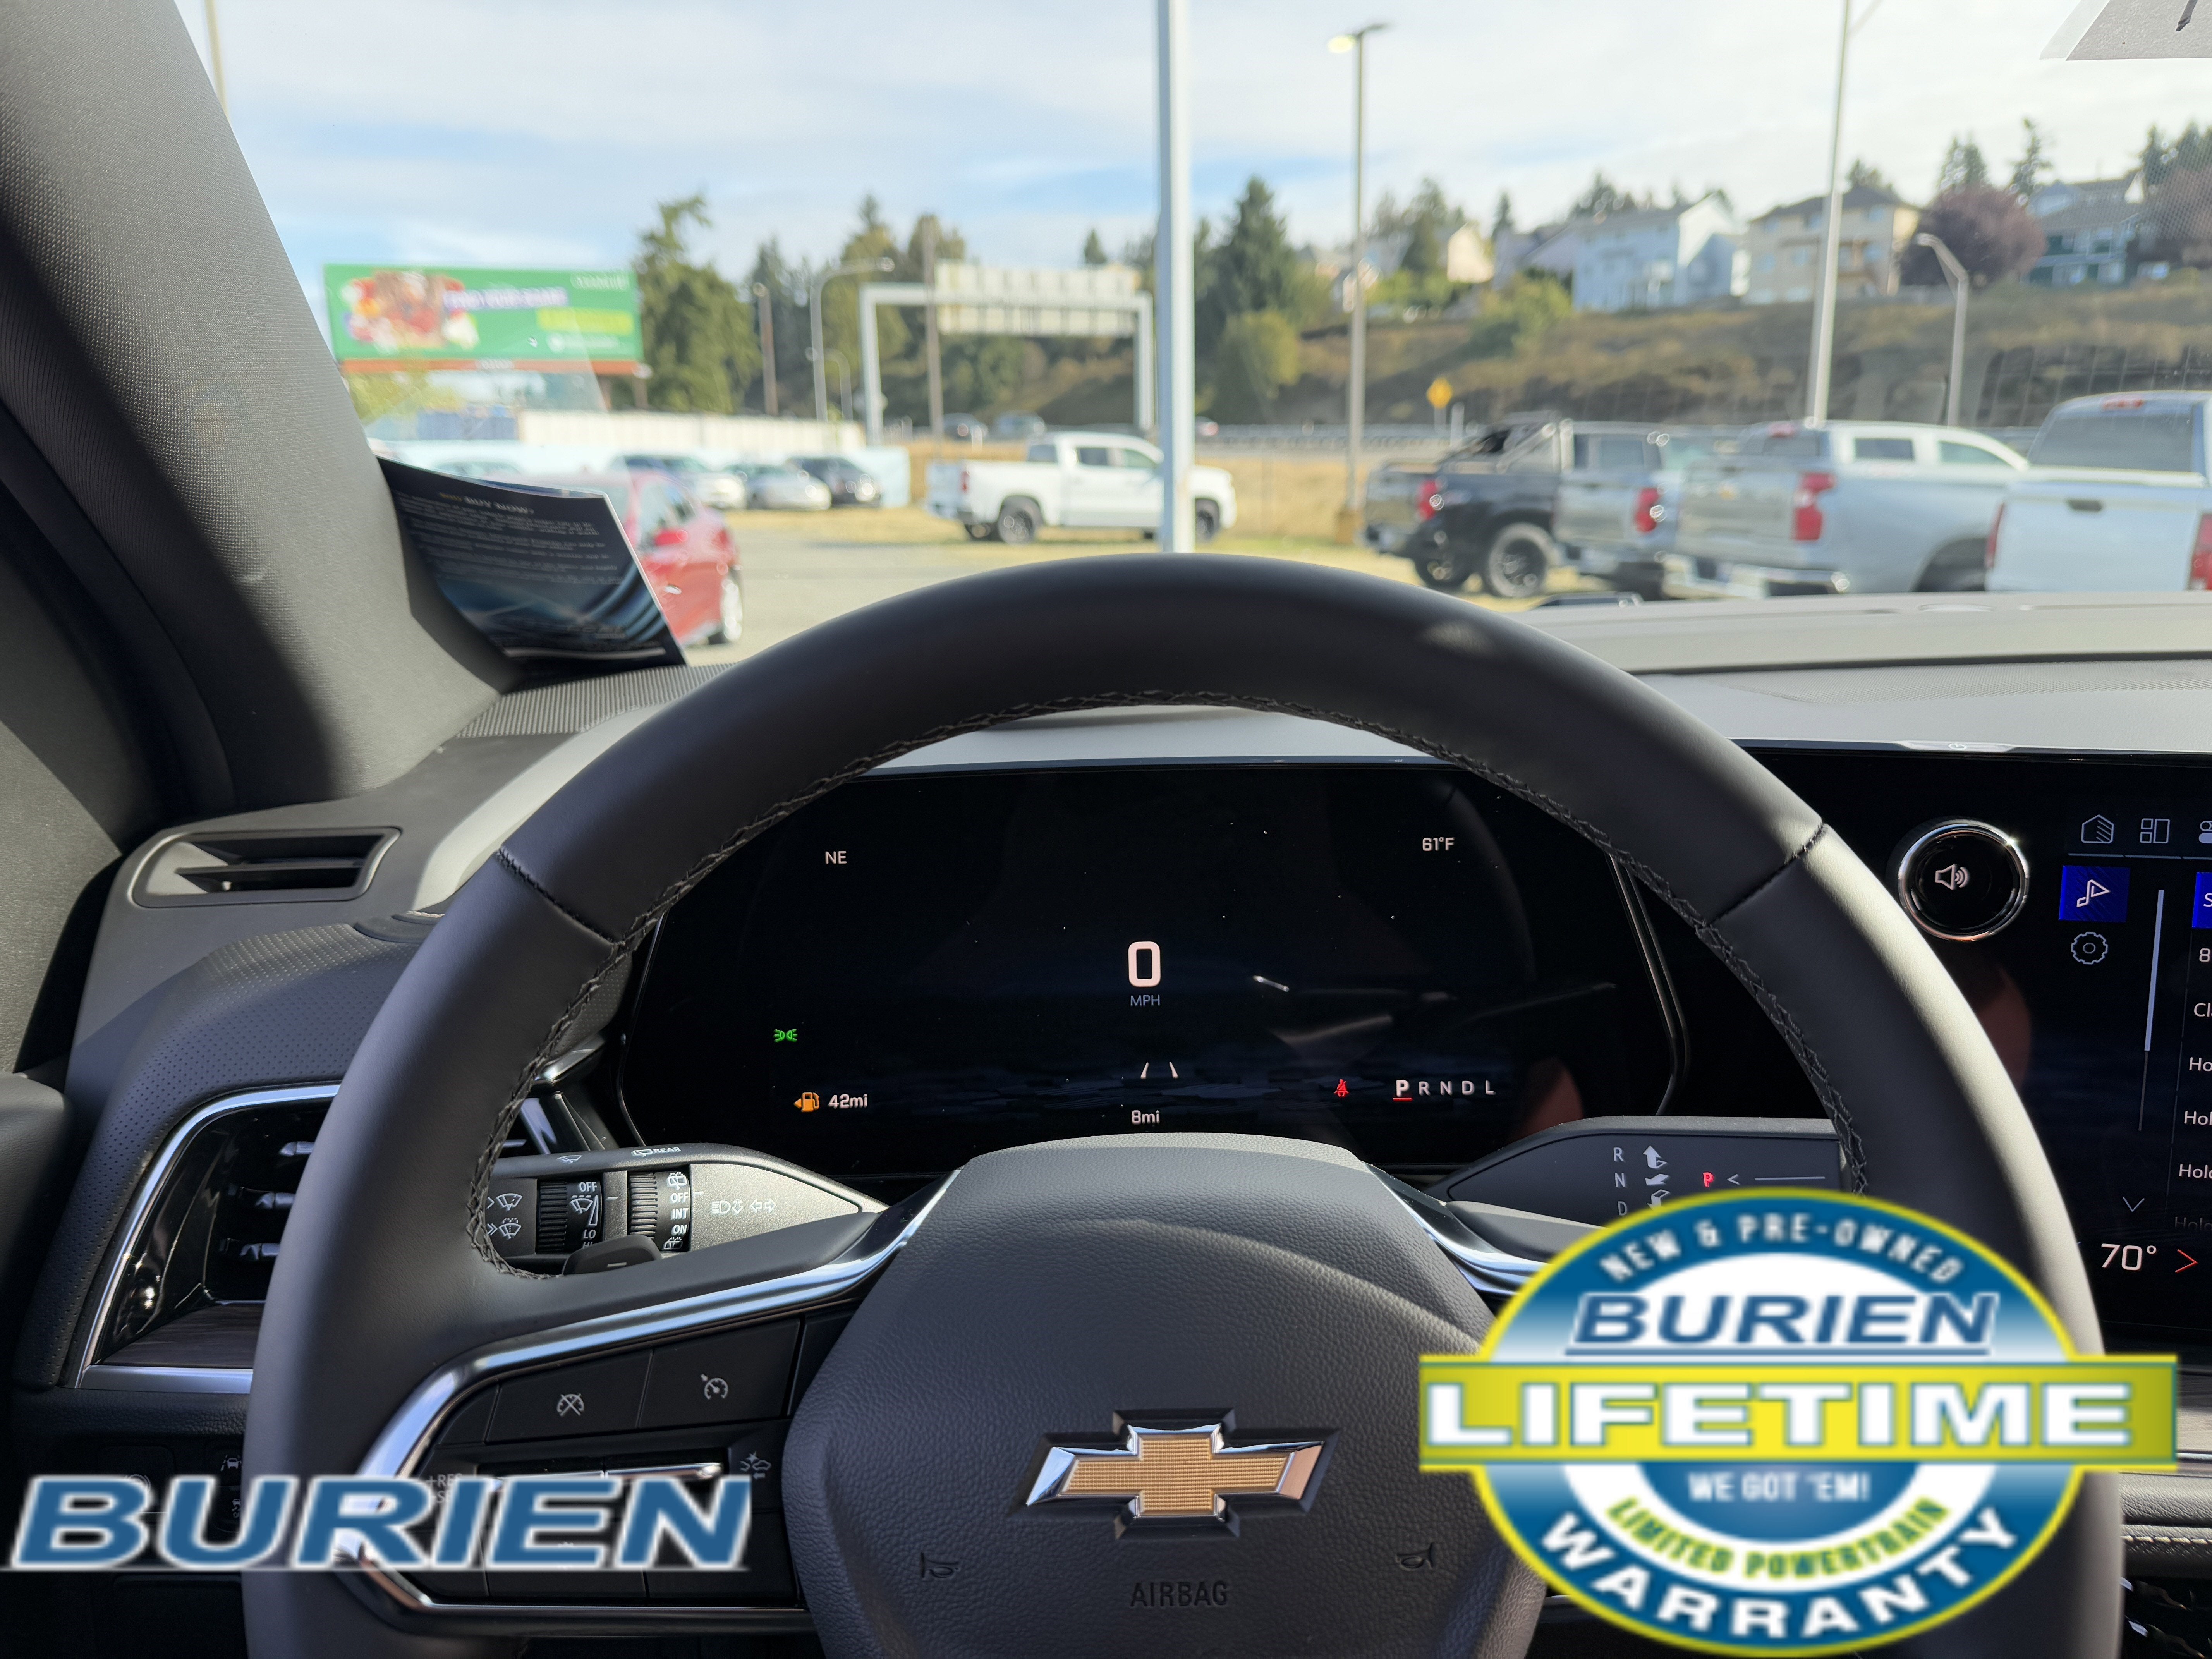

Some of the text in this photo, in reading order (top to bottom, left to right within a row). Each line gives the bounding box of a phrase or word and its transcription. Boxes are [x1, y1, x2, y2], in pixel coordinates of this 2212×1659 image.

[1422, 837, 1455, 851] 61°F
[825, 851, 847, 864] NE
[2199, 948, 2211, 962] 8
[1128, 941, 1161, 988] 0
[1130, 994, 1161, 1006] MPH
[2194, 1003, 2212, 1017] Cl
[1396, 1080, 1496, 1097] P R N D L
[828, 1094, 868, 1109] 42mi
[1131, 1110, 1160, 1124] 8mi
[1613, 1147, 1625, 1162] R
[1614, 1172, 1626, 1188] N
[1703, 1171, 1714, 1188] P
[579, 1181, 598, 1194] OFF
[669, 1192, 689, 1204] OFF
[670, 1208, 689, 1220] INT
[1618, 1201, 1628, 1216] D
[583, 1229, 596, 1239] LO
[671, 1224, 687, 1236] ON
[1130, 1581, 1228, 1607] AIRBAG
